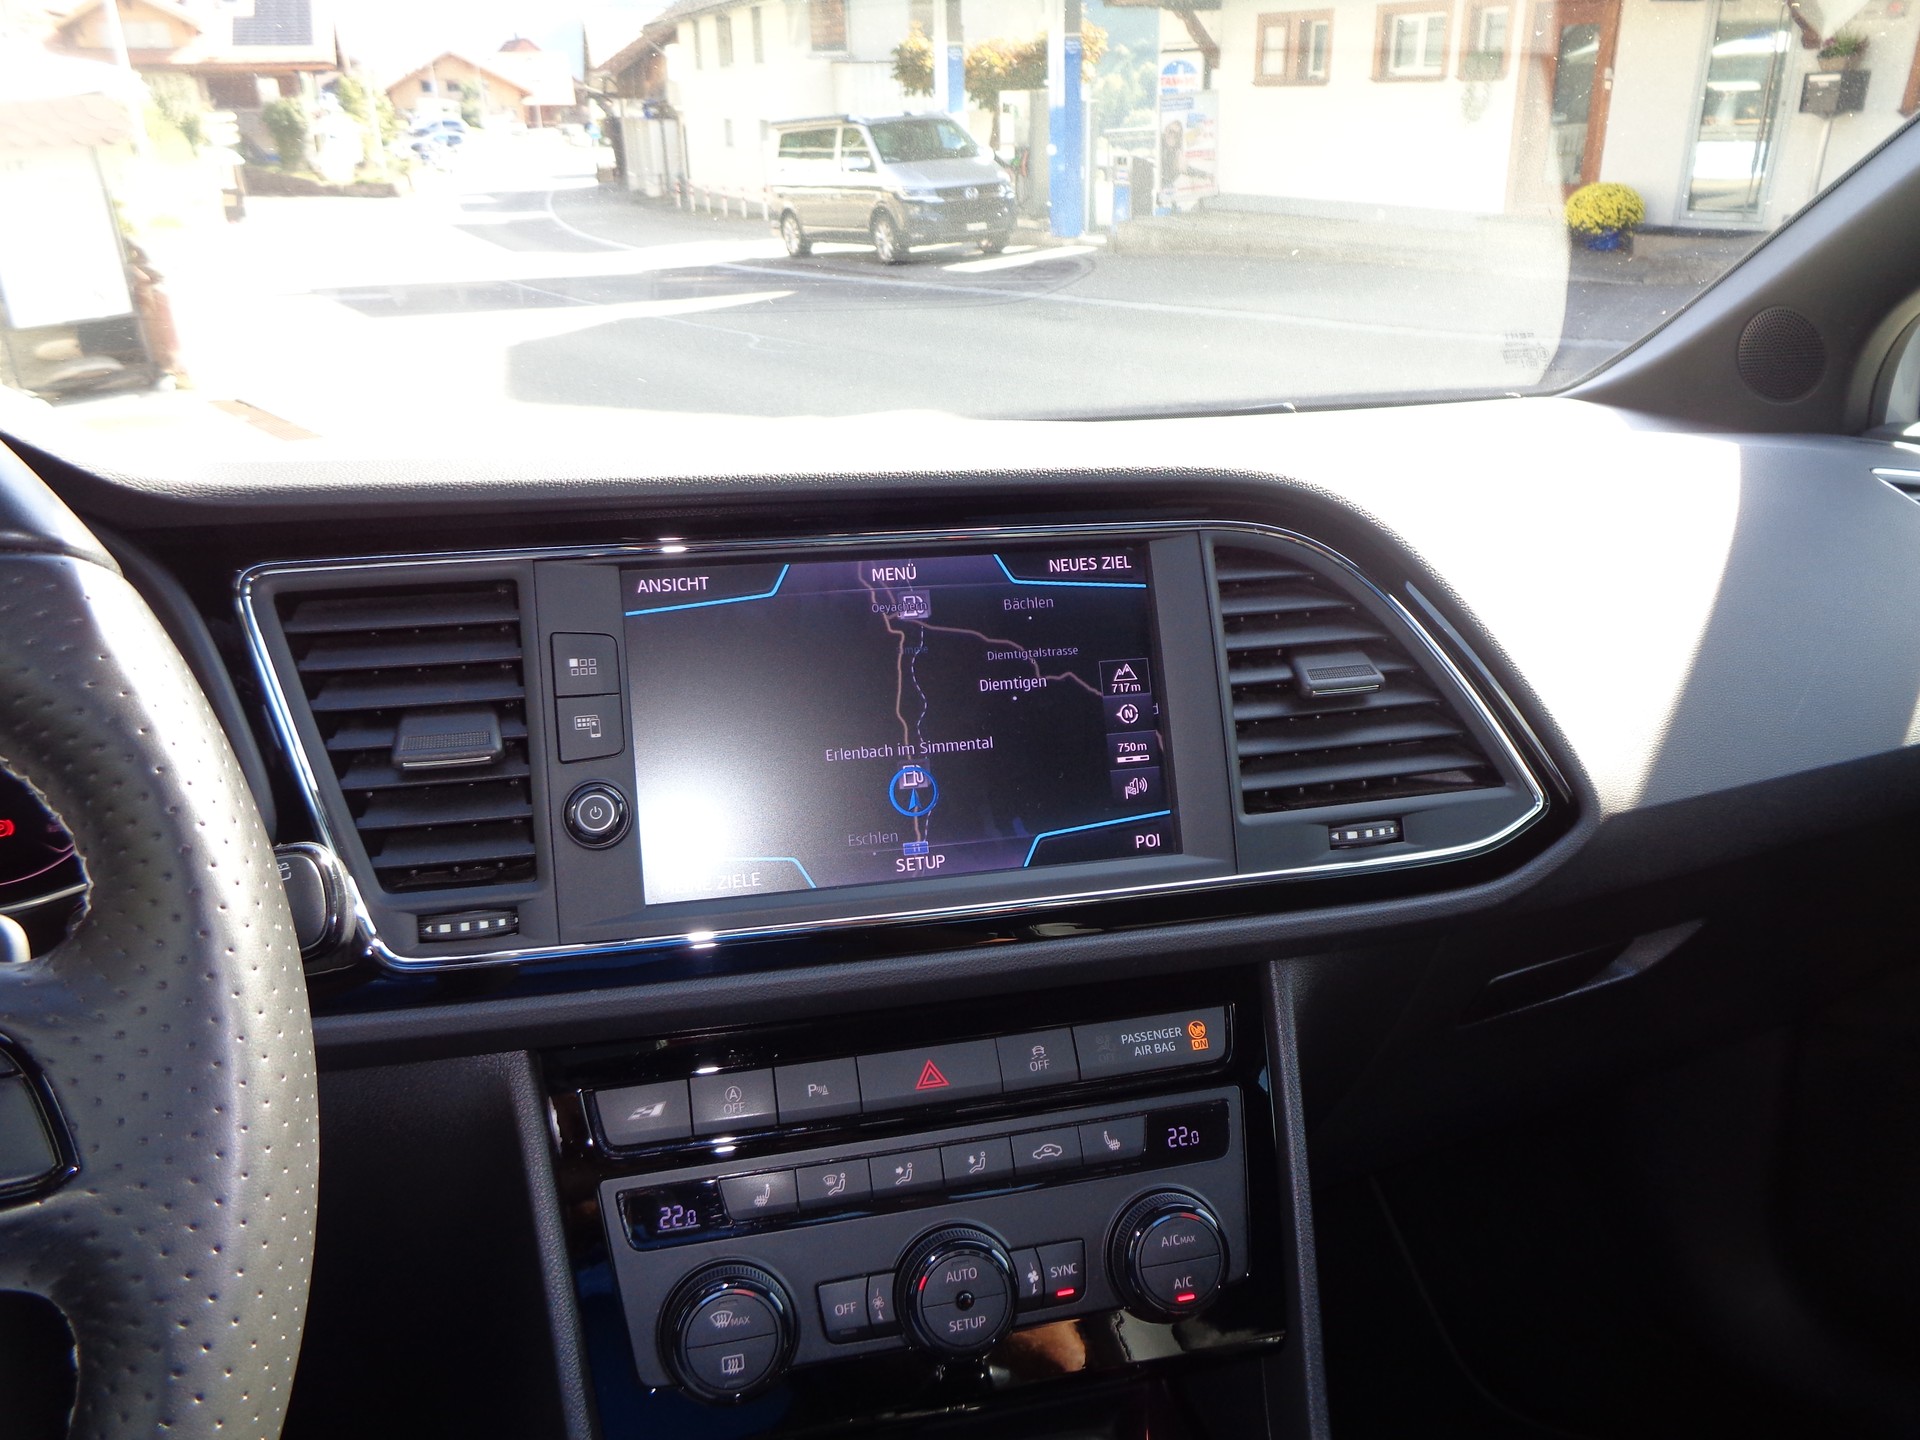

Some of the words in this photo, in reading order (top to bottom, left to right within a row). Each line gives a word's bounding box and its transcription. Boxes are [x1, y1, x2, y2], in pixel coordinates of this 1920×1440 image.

[1049, 558, 1097, 572] NEUES
[1102, 556, 1131, 570] ZIEL
[872, 564, 917, 581] MENÜ
[638, 576, 709, 593] ANSICHT
[1003, 597, 1054, 611] Bächlen
[987, 646, 1079, 661] Diemtigtalstrasse
[979, 676, 1047, 692] Diemtigen
[1111, 683, 1141, 694] 717m
[826, 744, 893, 761] Erlenbach
[898, 743, 915, 755] im
[920, 736, 994, 754] Simmental
[1117, 742, 1148, 752] 750m
[848, 832, 899, 847] Eschlen
[1135, 834, 1161, 848] POI
[896, 855, 946, 872] SETUP
[717, 872, 762, 890] ZIELE
[1121, 1027, 1182, 1044] PASSENGER
[1134, 1045, 1152, 1057] AIR
[1154, 1041, 1176, 1054] BAG
[1193, 1040, 1207, 1050] ON
[1030, 1059, 1050, 1072] OFF
[723, 1102, 746, 1115] OFF
[945, 1267, 978, 1283] AUTO
[1050, 1262, 1079, 1278] SYNC
[1174, 1276, 1193, 1290] A/C
[834, 1301, 857, 1316] OFF
[731, 1315, 751, 1327] MAX
[949, 1315, 986, 1332] SETUP
